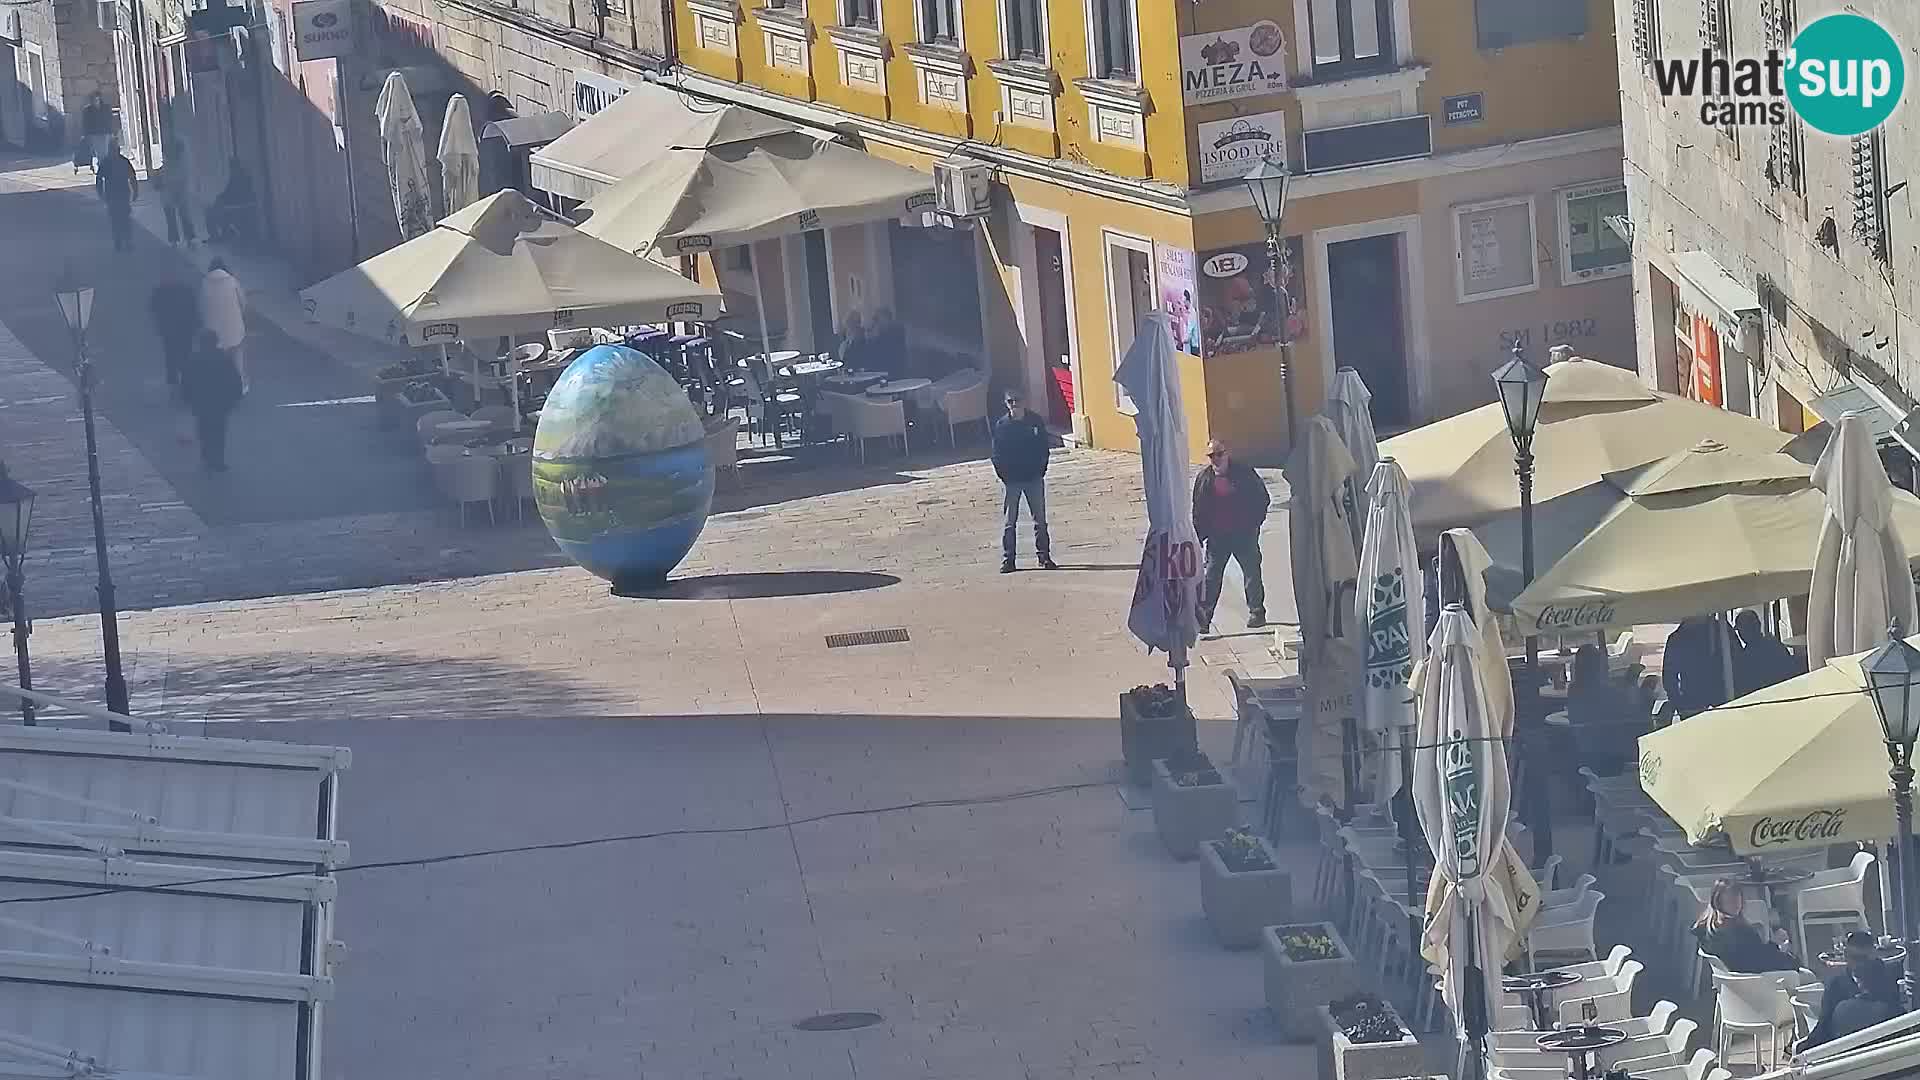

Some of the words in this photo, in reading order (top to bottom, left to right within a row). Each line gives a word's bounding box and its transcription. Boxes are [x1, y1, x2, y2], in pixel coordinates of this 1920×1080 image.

[1186, 60, 1265, 91] MEZA
[1195, 86, 1228, 99] PIZZERIA
[1235, 83, 1257, 94] GRILL
[1204, 146, 1250, 165] ISPOD
